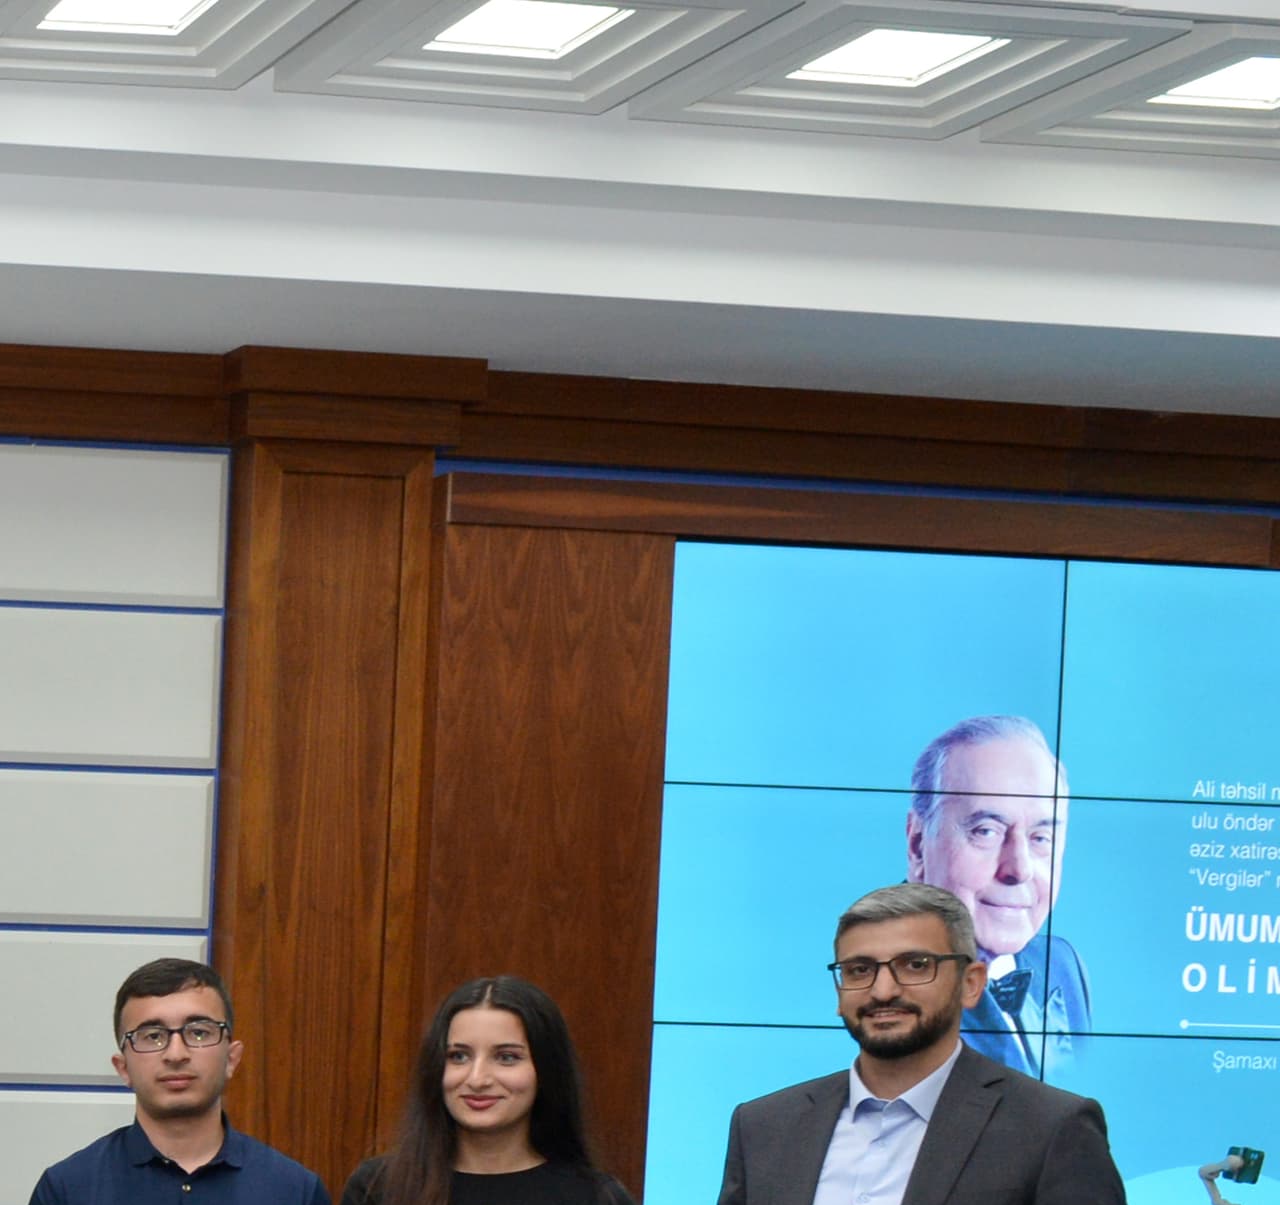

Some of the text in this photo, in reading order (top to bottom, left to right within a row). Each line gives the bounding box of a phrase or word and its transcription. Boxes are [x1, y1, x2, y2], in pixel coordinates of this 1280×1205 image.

[1192, 780, 1216, 798] Ali
[1221, 782, 1267, 801] təhsil
[1191, 811, 1275, 831] ulu öndər
[1190, 840, 1280, 861] əziz xatirə
[1185, 906, 1280, 943] ÜMUM
[1212, 1050, 1277, 1073] Şamaxı
